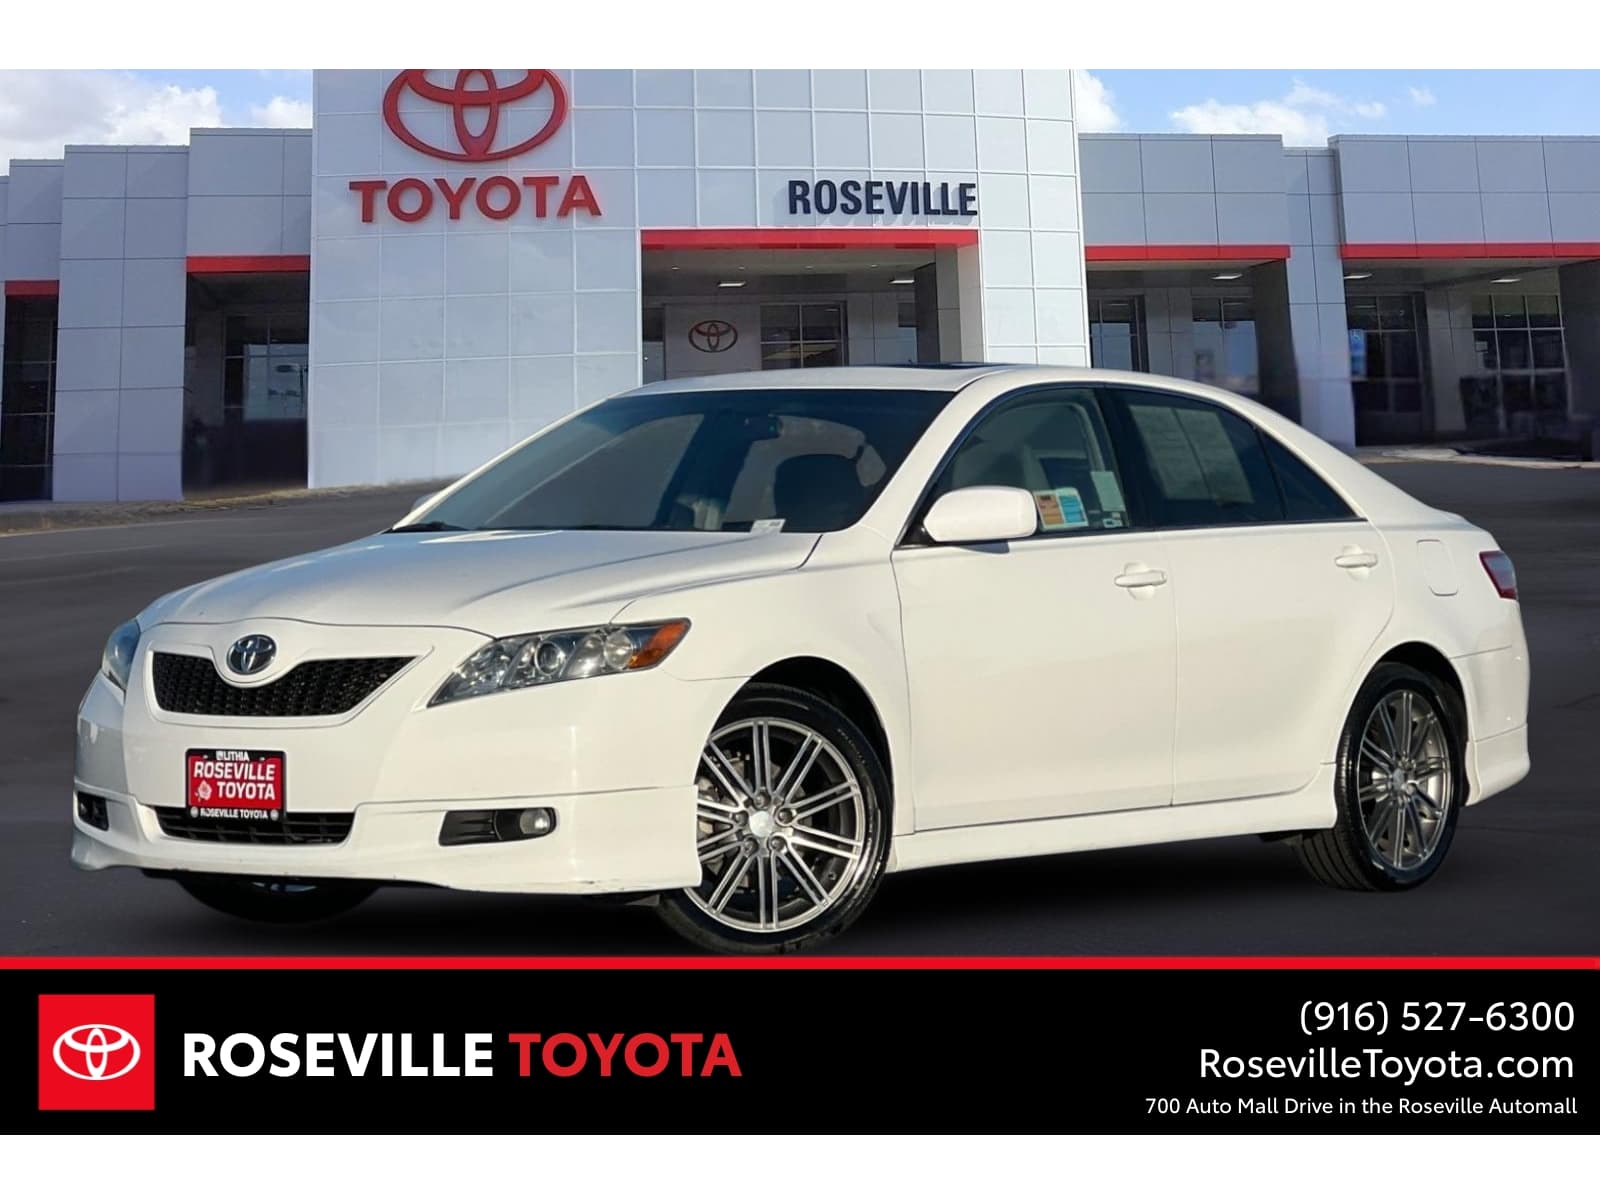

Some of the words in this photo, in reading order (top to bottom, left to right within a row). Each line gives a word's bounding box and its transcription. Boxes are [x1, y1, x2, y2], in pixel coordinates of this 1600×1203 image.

[349, 175, 602, 222] TOYOTA
[788, 179, 978, 216] ROSEVILLE
[223, 751, 250, 761] LITHIA
[193, 761, 276, 781] ROSEVILLE
[216, 781, 276, 800] TOYOTA
[200, 807, 239, 819] ROSEVILLE
[240, 808, 269, 819] TOYOTA
